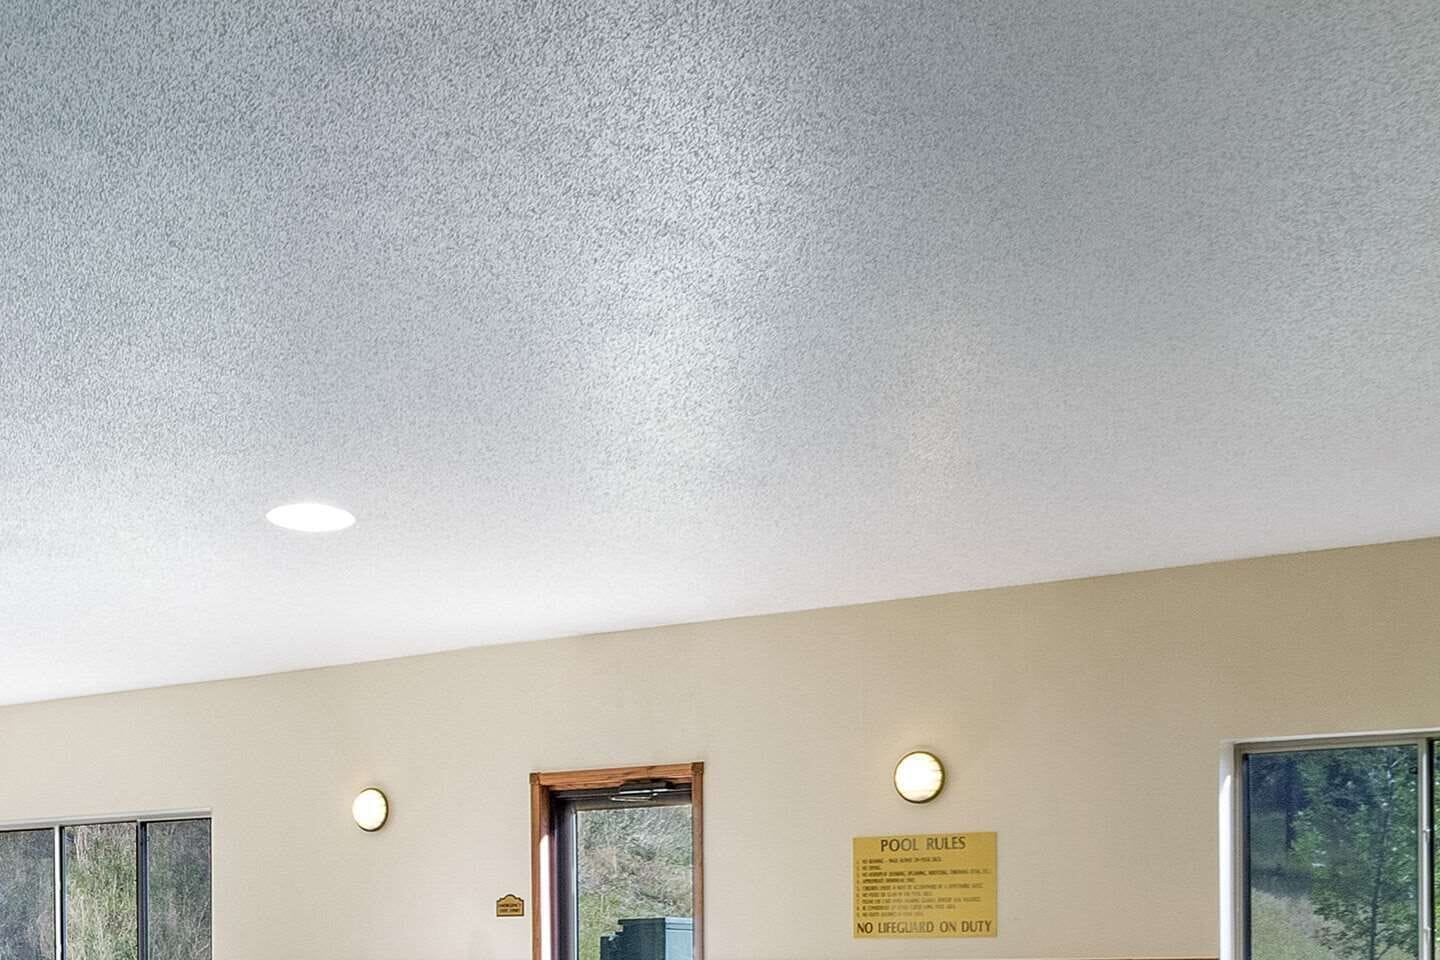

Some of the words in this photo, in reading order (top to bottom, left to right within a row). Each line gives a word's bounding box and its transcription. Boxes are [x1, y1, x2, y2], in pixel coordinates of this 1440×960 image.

[880, 837, 919, 852] POOL
[925, 836, 966, 850] RULES
[856, 922, 873, 934] NO
[878, 921, 935, 934] LIFEGUARD
[939, 920, 957, 933] ON
[961, 920, 992, 933] DUTY
